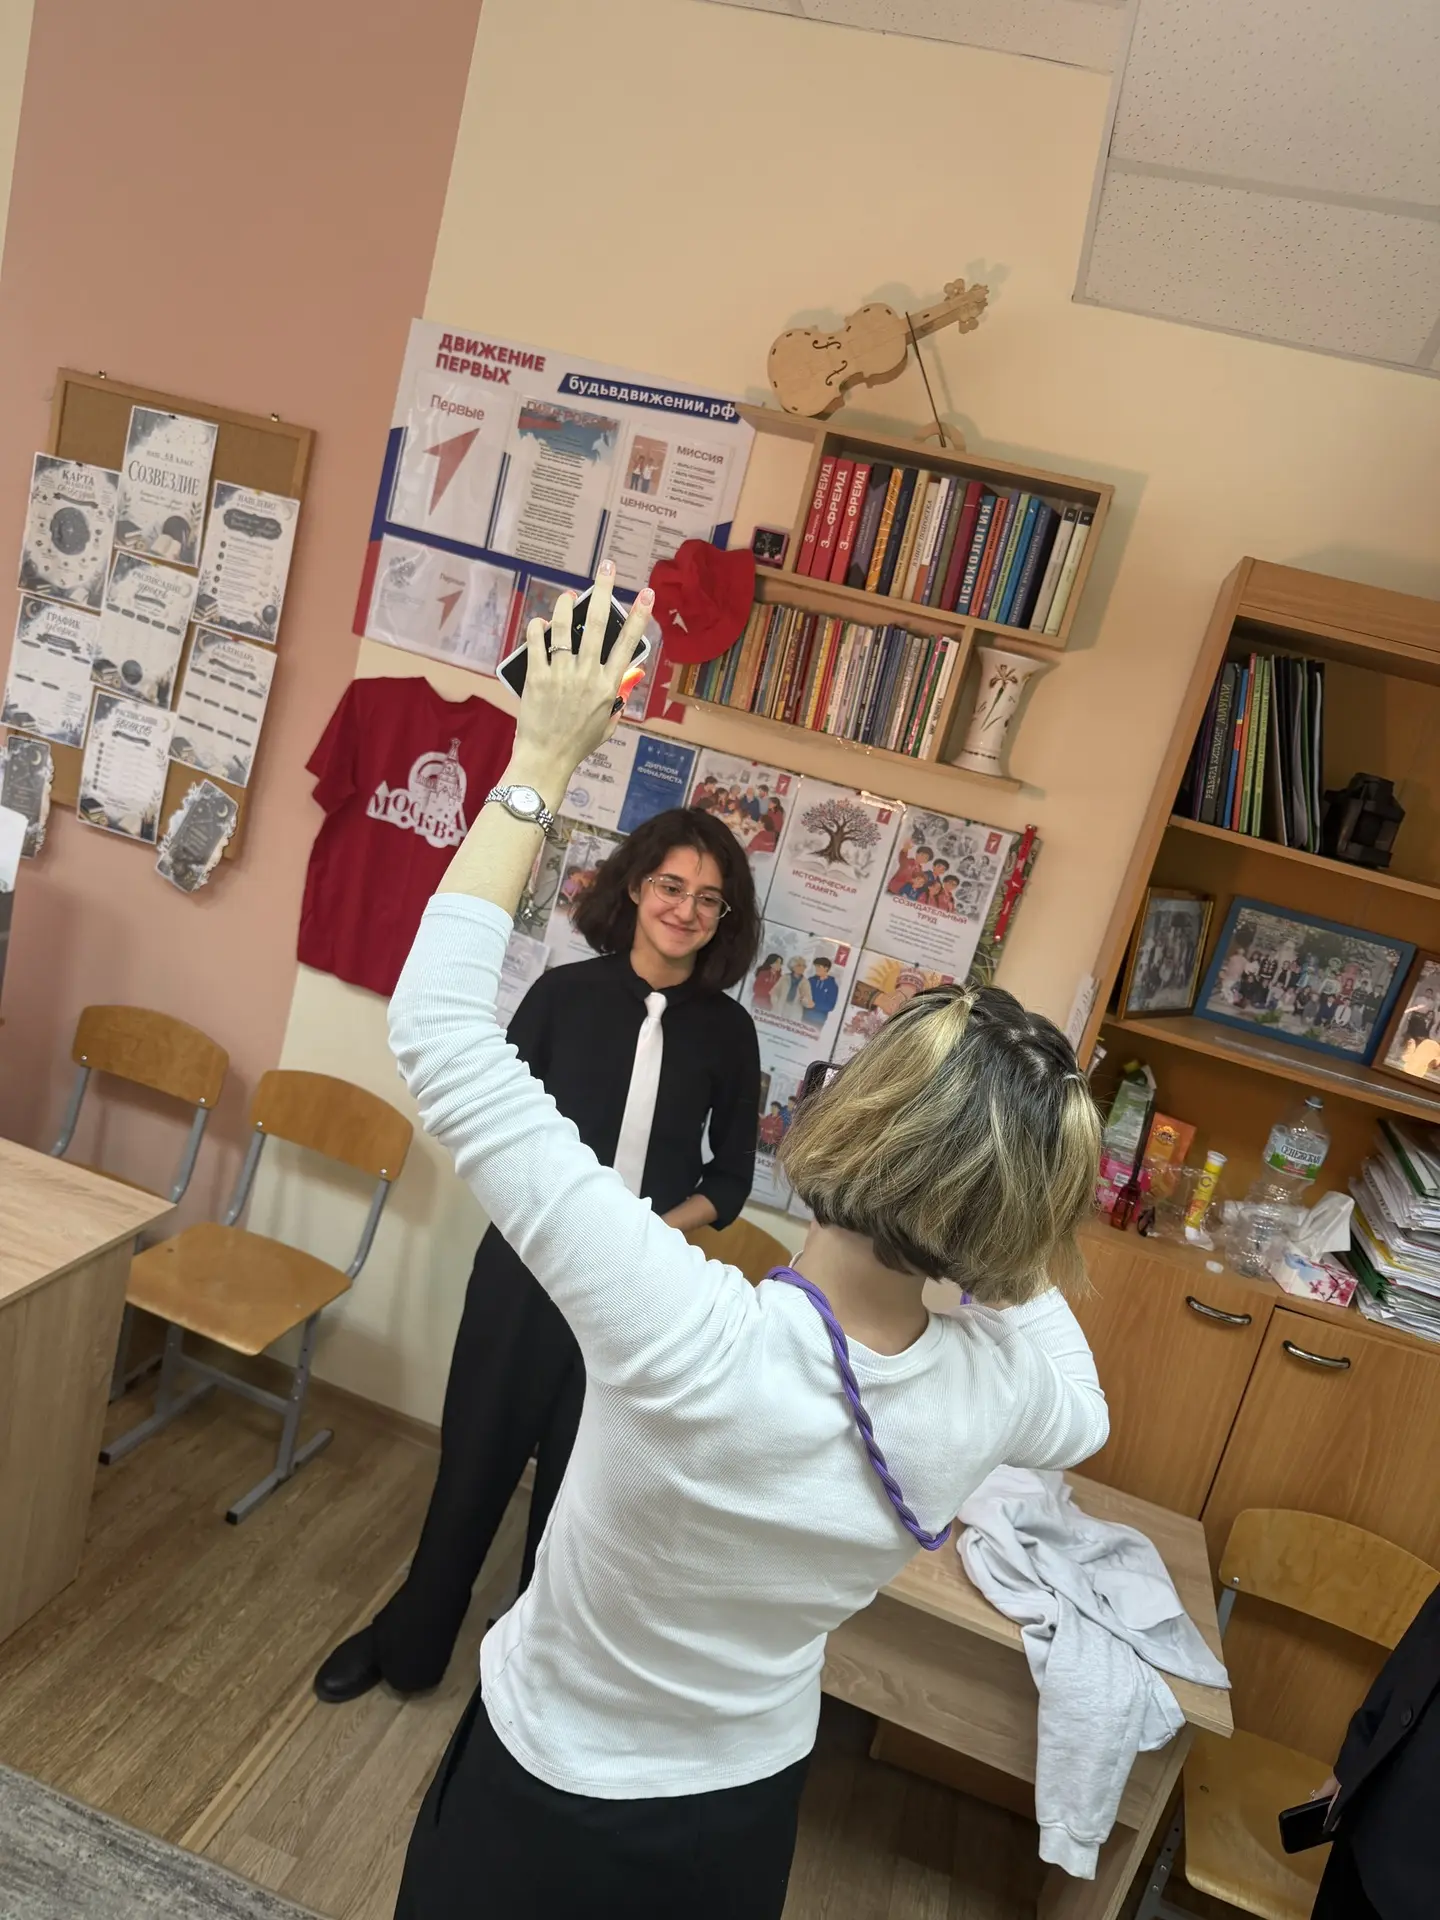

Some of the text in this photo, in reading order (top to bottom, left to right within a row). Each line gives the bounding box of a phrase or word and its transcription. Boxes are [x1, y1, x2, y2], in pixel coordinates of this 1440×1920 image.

[439, 333, 546, 372] ДВИЖЕНИЕ
[436, 353, 512, 385] ПЕРВЫХ
[430, 394, 485, 421] Первые
[568, 376, 736, 420] будьвдвижении.рф
[677, 445, 724, 465] МИССИЯ
[62, 470, 95, 486] КАРТА
[128, 460, 200, 497] СОЗВЕЗДИЕ
[812, 461, 833, 510] ФРЕЙД
[846, 468, 867, 517] ФРЕЙД
[620, 497, 677, 519] ЦЕННОСТИ
[824, 468, 848, 526] ФРЕЙД
[917, 498, 933, 540] ПОДРОСТКА
[957, 502, 993, 604] ПСИХОЛОГИЯ
[47, 611, 81, 630] ГРАФИК
[1214, 682, 1232, 724] МАУГЛИ
[636, 766, 684, 786] ФИНАЛИСТА
[644, 760, 679, 776] ДИПЛОМ
[371, 793, 463, 839] МОСКВА
[792, 868, 857, 896] ИСТОРИЧЕСКАЯ
[804, 881, 839, 898] ПАМЯТЬ
[892, 896, 968, 925] СОЗИДАТЕЛЬНЫЙ
[917, 912, 937, 925] ТРУД
